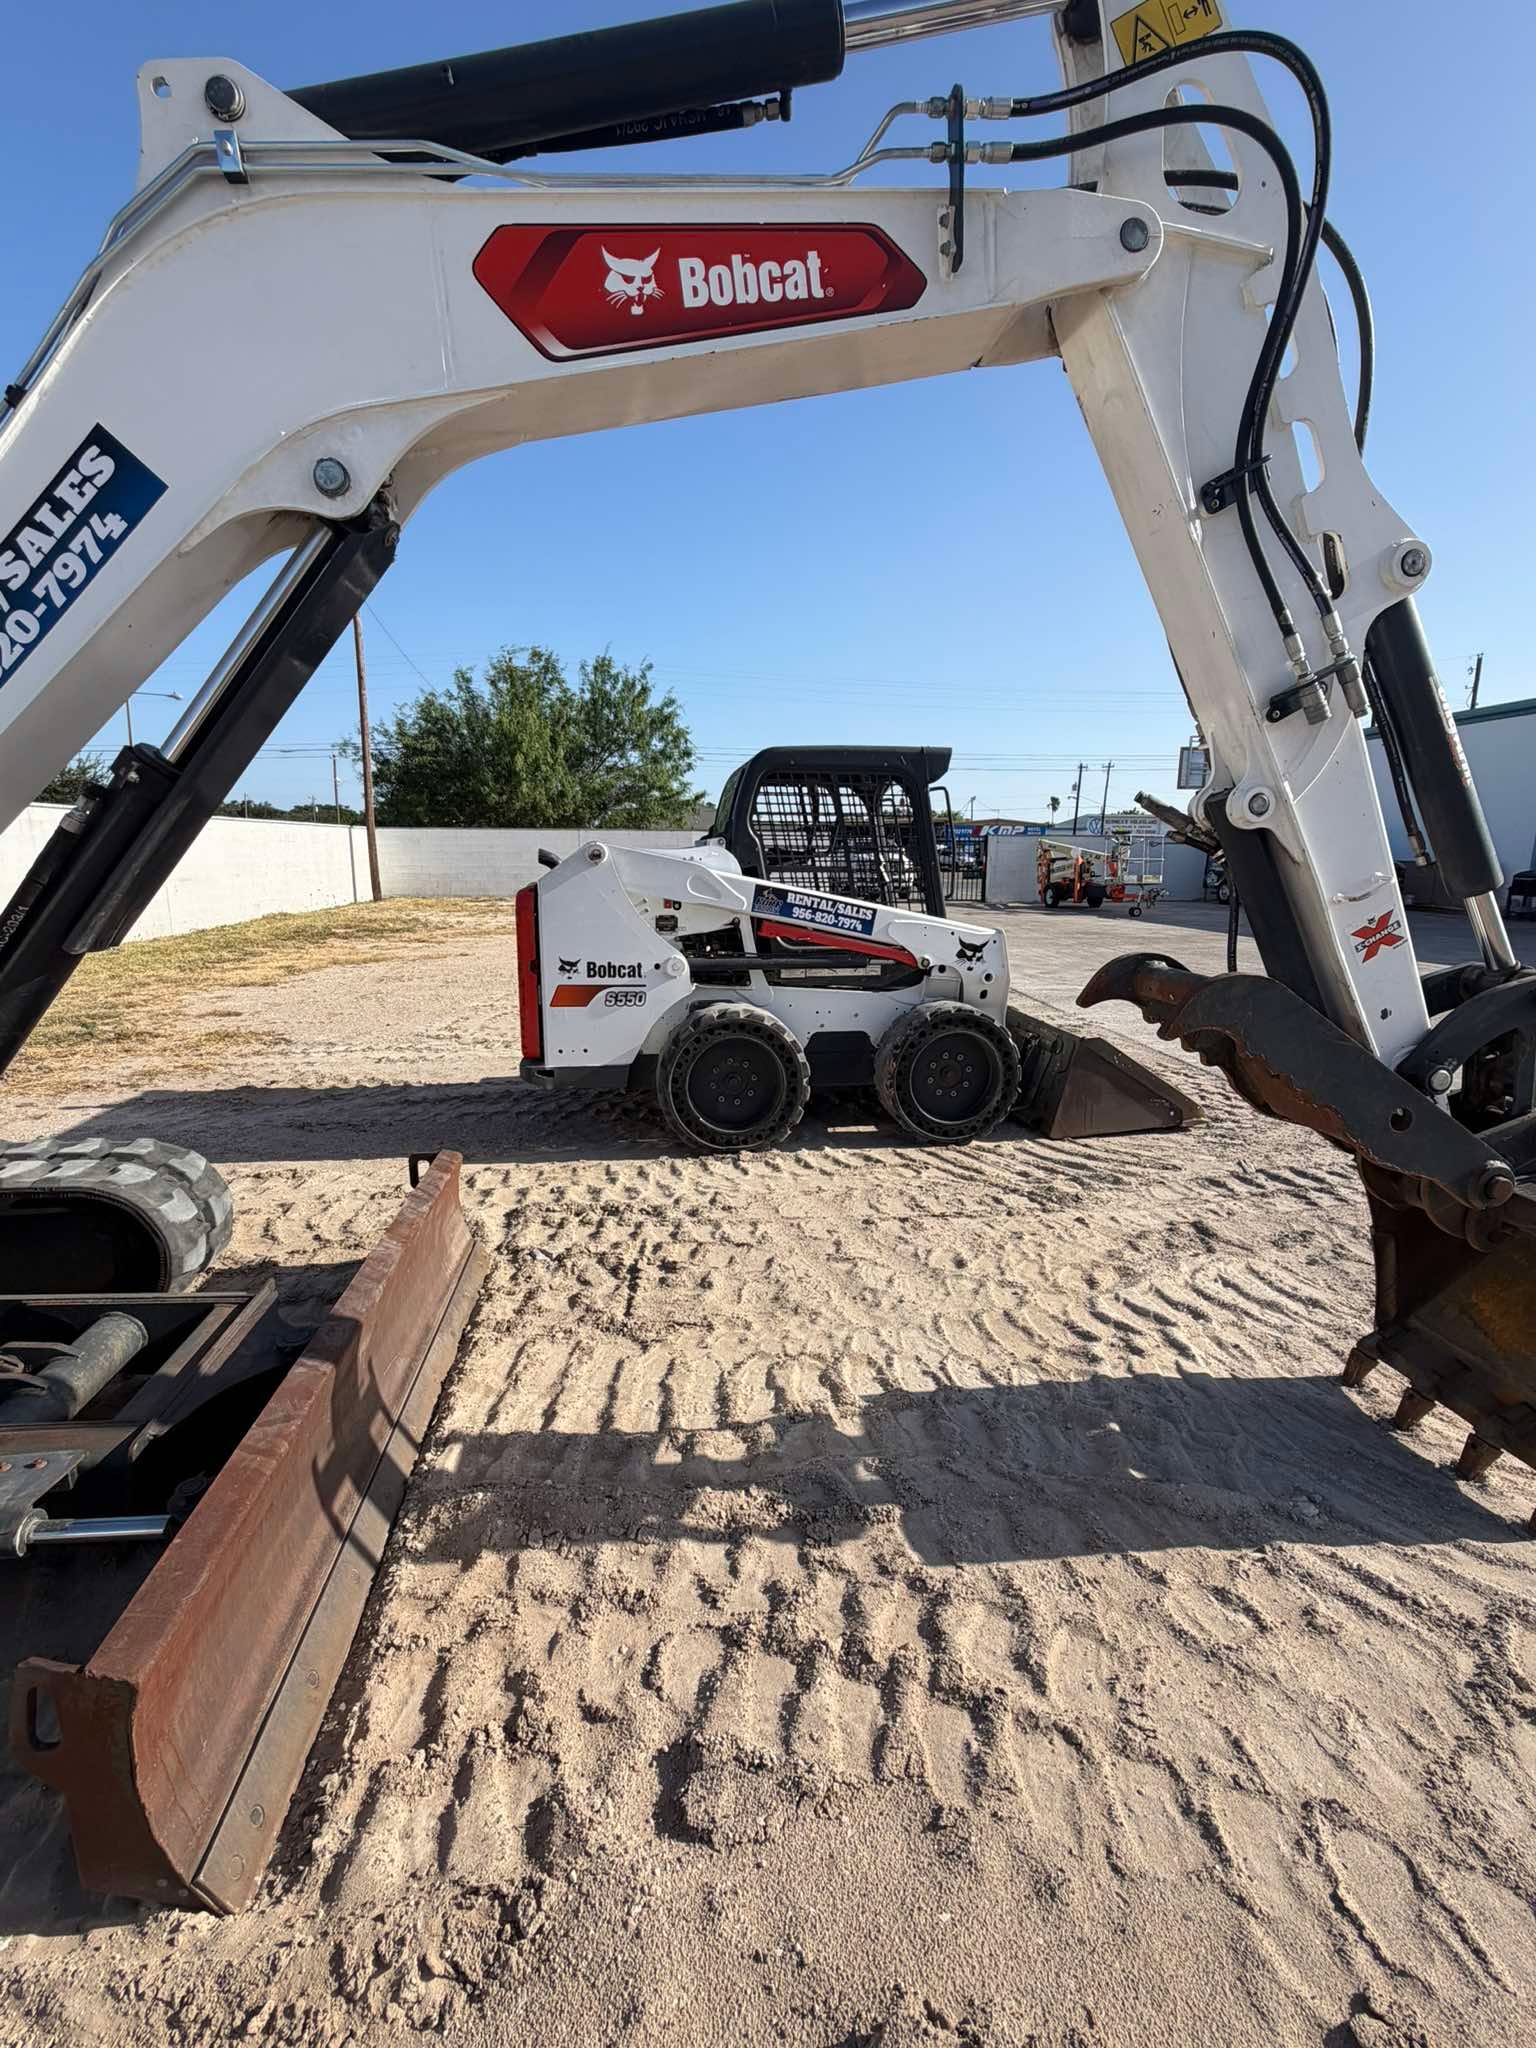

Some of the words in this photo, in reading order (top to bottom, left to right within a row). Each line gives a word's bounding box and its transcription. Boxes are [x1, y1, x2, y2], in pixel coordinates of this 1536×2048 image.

[678, 251, 825, 308] Bobcat
[0, 512, 129, 678] 20-7974
[786, 892, 874, 920] RENTAL/SALES
[791, 906, 863, 931] 956-820-7974
[1354, 920, 1401, 953] X-CHANGE
[586, 961, 643, 979] Bobcat
[603, 990, 648, 1008] S550
